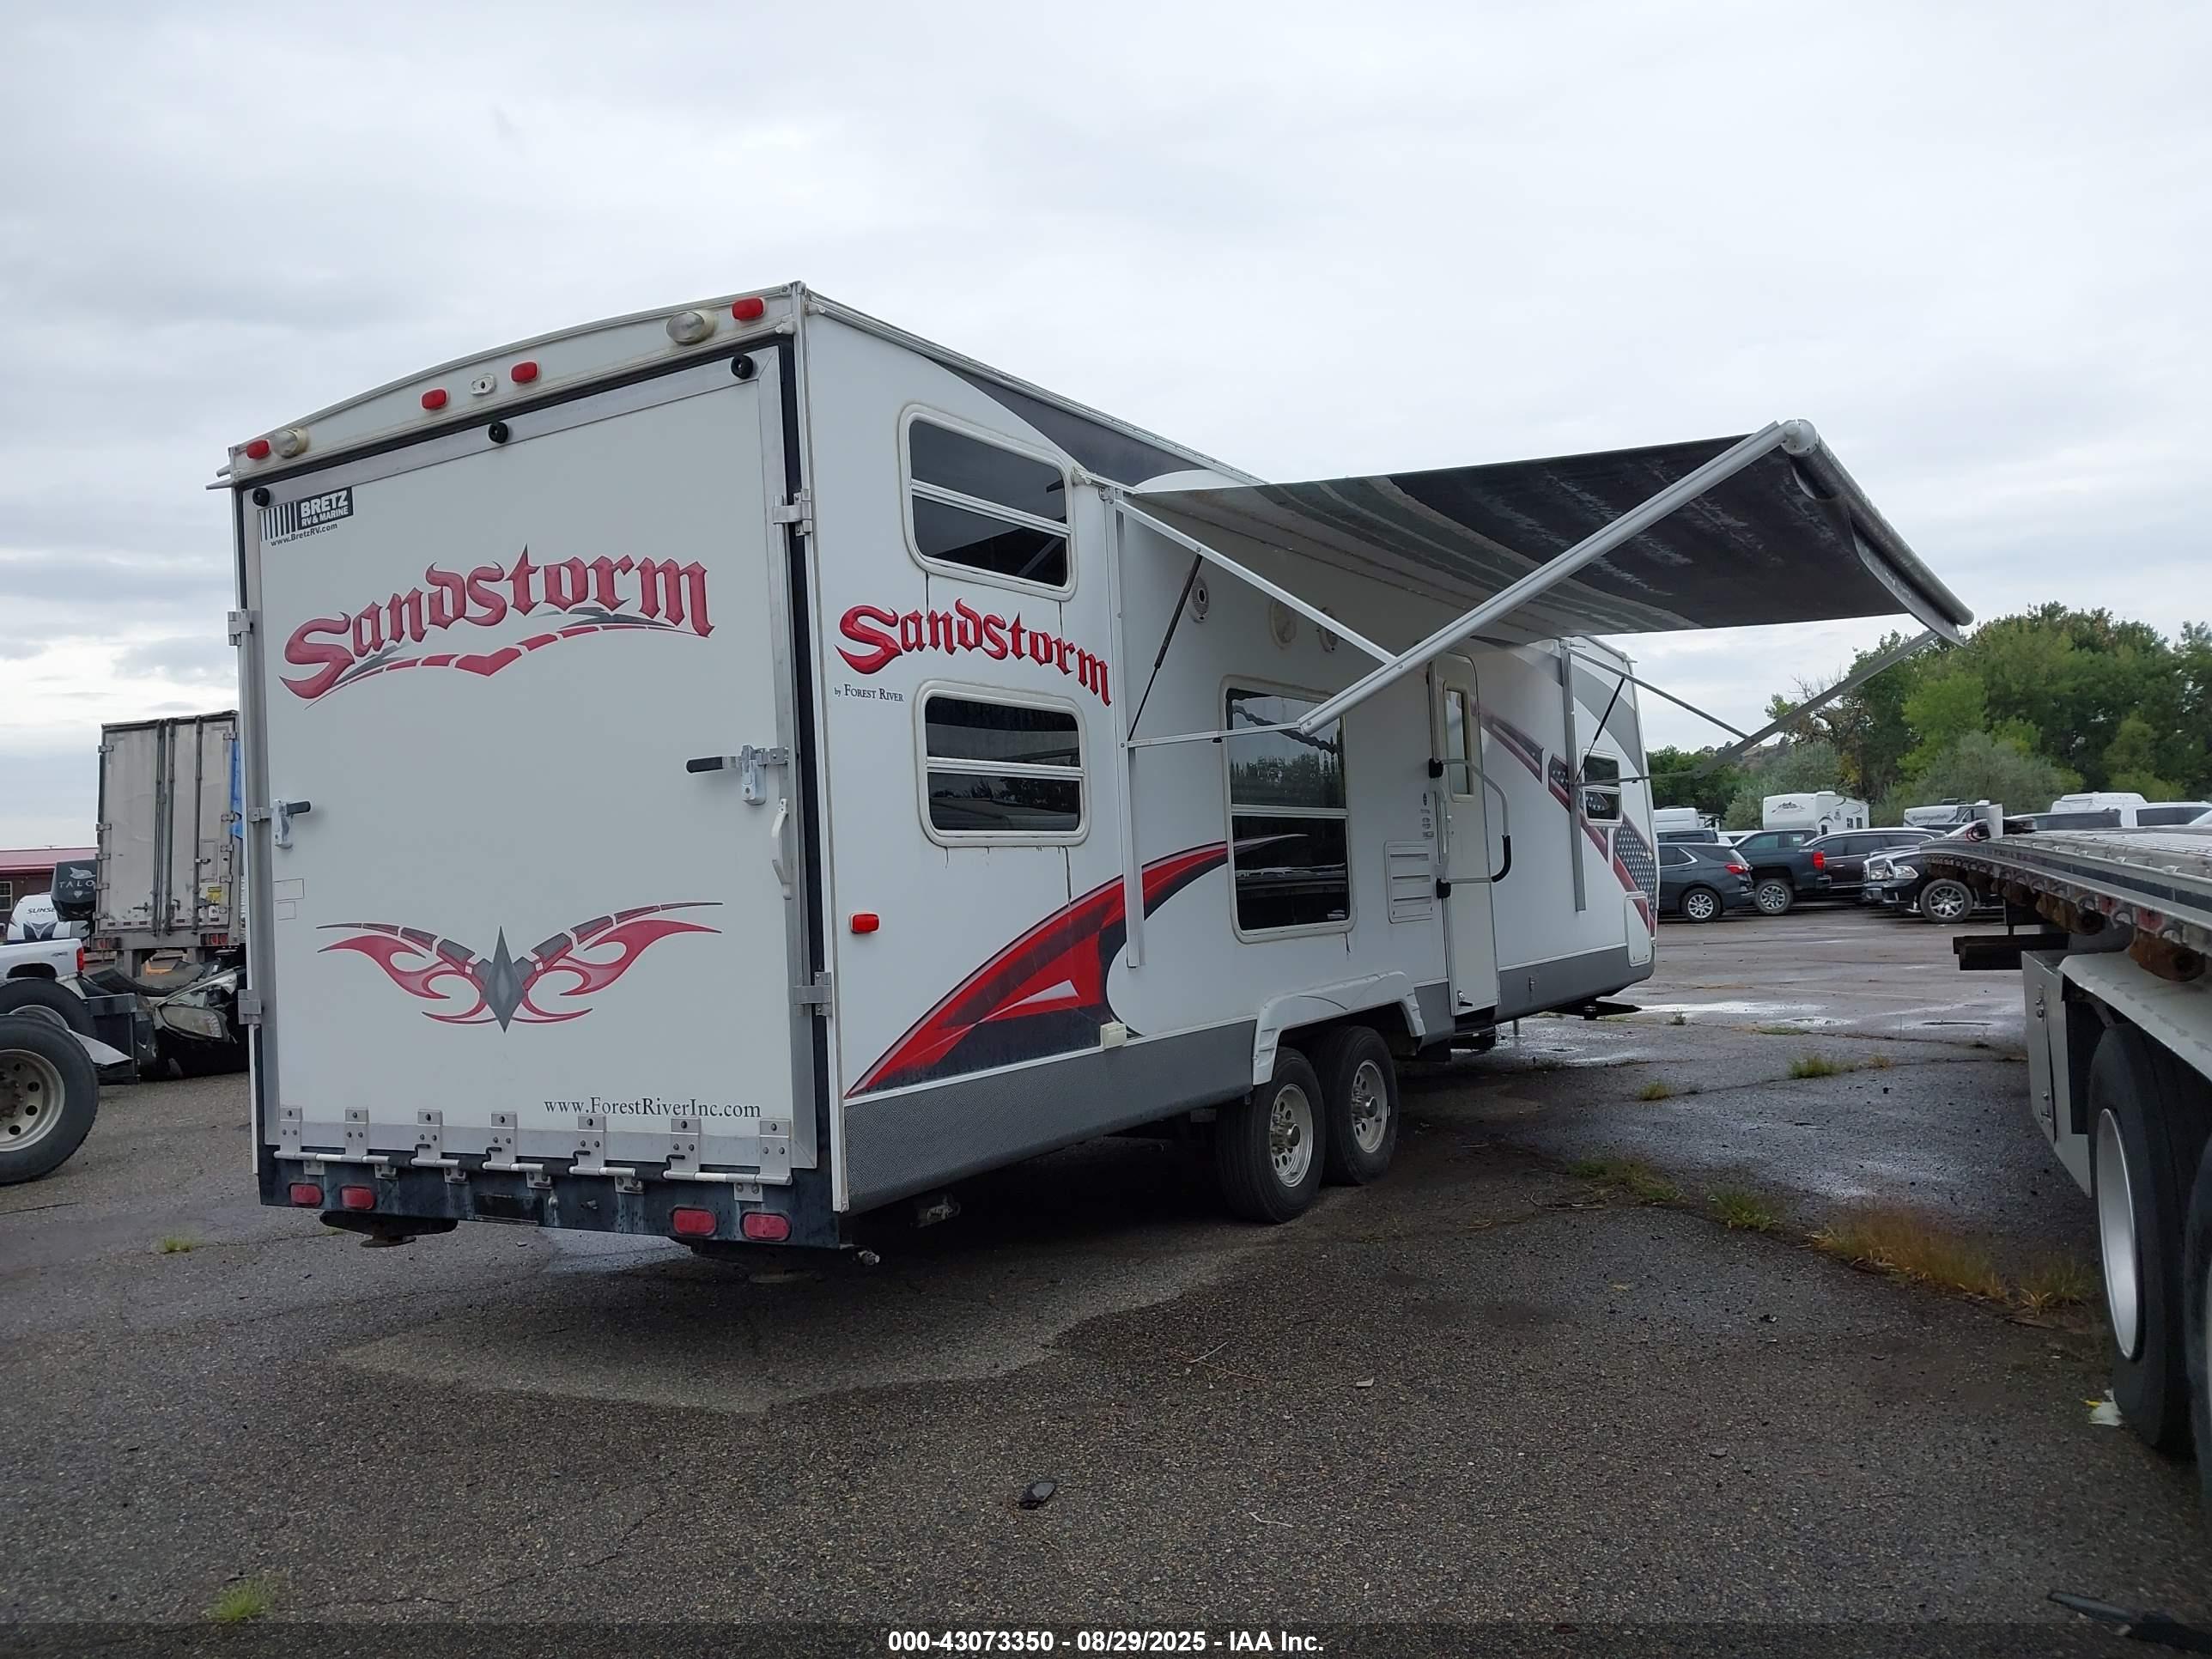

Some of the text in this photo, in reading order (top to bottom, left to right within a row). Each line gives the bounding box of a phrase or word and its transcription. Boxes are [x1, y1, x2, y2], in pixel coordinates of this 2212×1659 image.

[301, 490, 348, 517] BRETZ
[319, 506, 349, 521] MARINE
[270, 523, 337, 546] www.BretzRV.com
[278, 543, 715, 699] Sandstorm
[834, 598, 1112, 707] Sandstorm
[834, 684, 905, 702] by FOREST RIVER
[544, 1097, 762, 1118] www.ForestRiverInc.com
